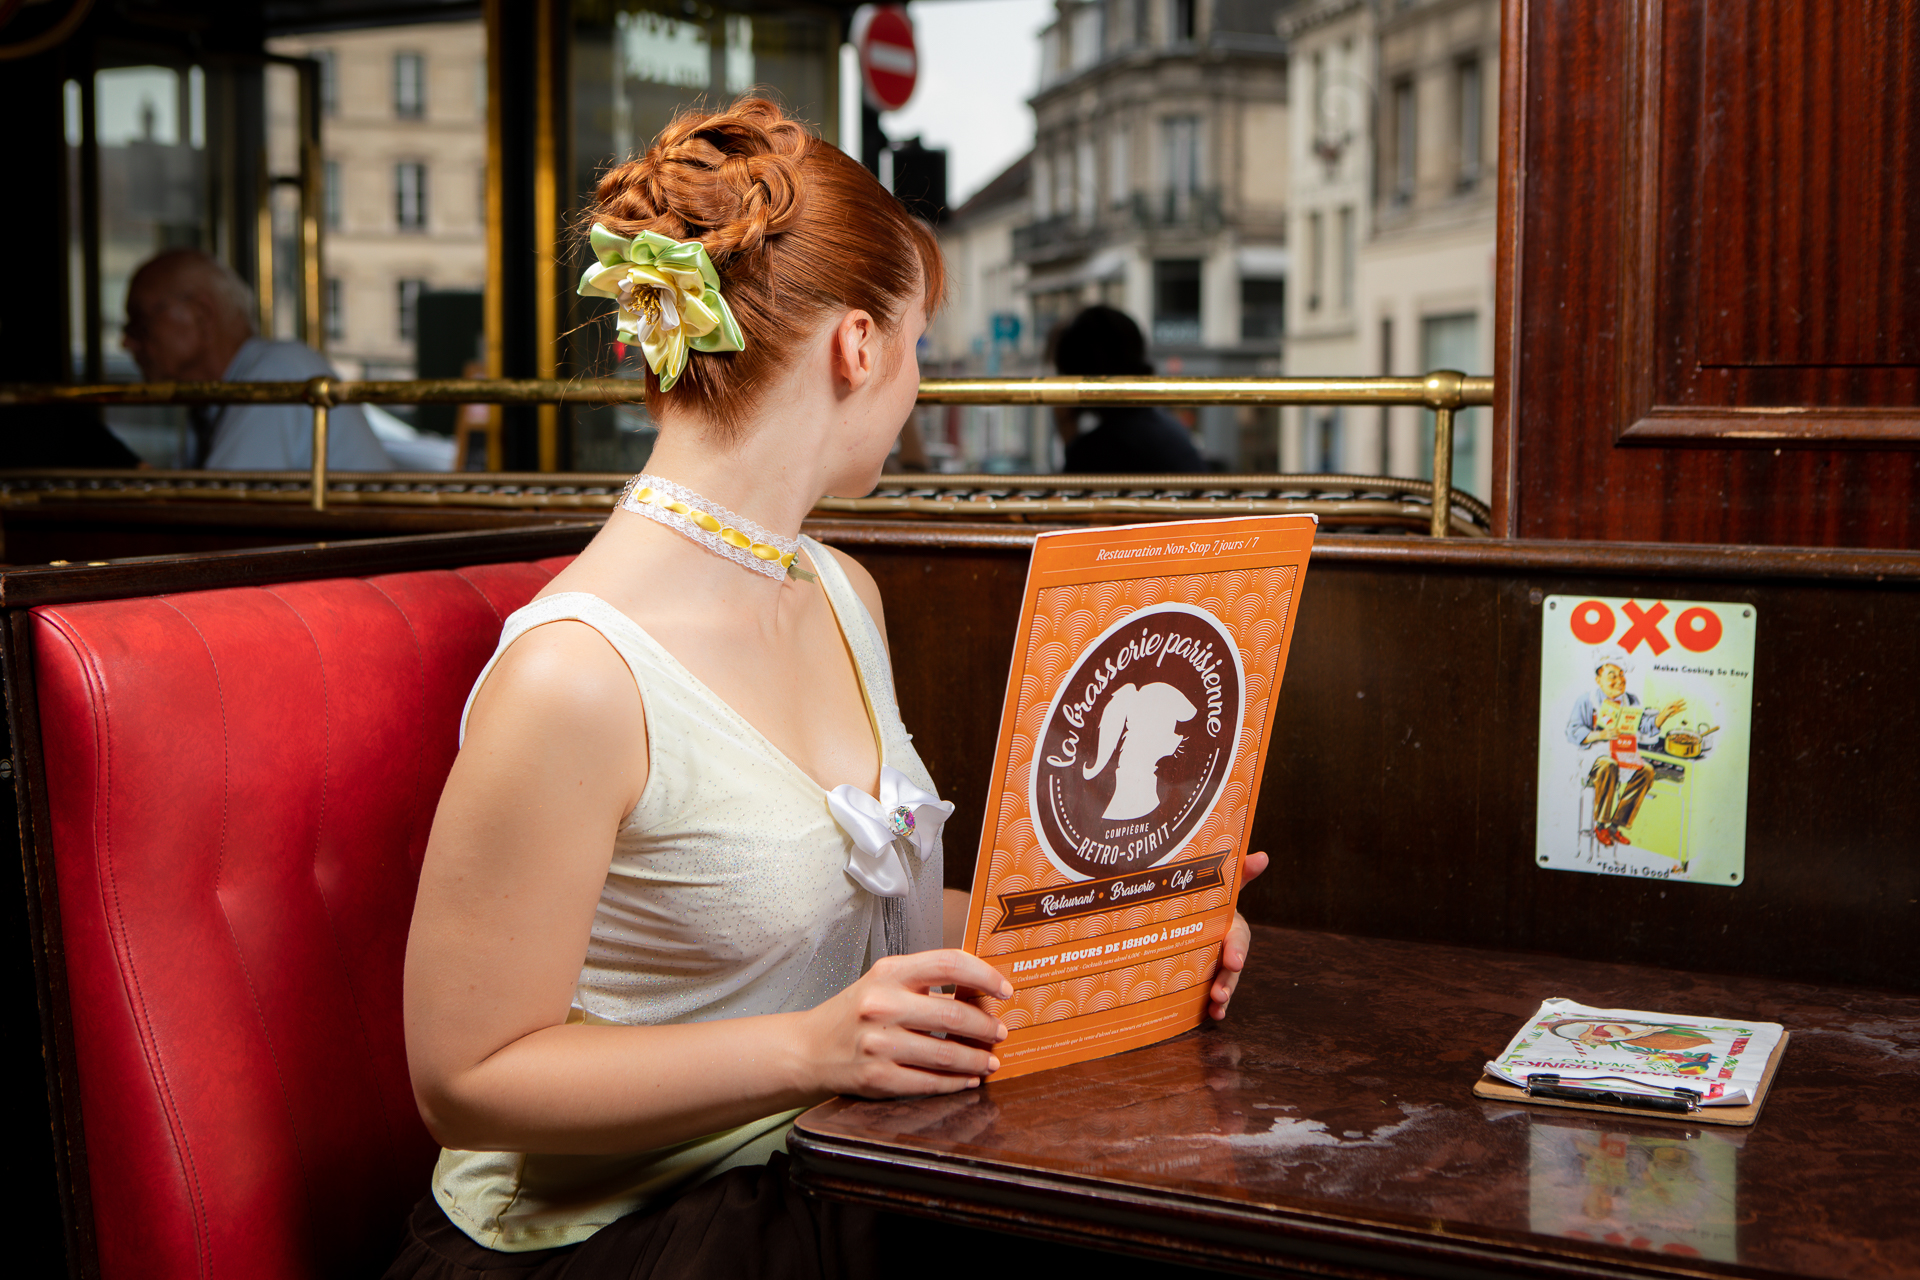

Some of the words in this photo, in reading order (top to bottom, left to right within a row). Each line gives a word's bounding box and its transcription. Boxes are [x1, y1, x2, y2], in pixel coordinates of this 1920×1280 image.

[1163, 541, 1211, 557] Non-Stop
[1212, 540, 1219, 552] 7
[1215, 539, 1244, 556] jours
[1252, 536, 1259, 548] 7
[1096, 545, 1162, 561] Restauration
[1570, 598, 1723, 657] OXO
[1681, 665, 1714, 677] Cooking
[1046, 730, 1080, 768] la
[1063, 628, 1164, 728] brasserie
[1156, 632, 1223, 738] parisienne
[1105, 822, 1150, 840] COMPIÈGNE
[1076, 822, 1170, 865] RETRO-SPIRIT
[1630, 865, 1638, 875] is
[1041, 889, 1095, 916] Restaurant
[1110, 879, 1156, 900] Brasserie
[1170, 869, 1194, 889] Café
[1012, 955, 1058, 973] HAPPY
[1060, 946, 1102, 963] HOURS
[1104, 942, 1120, 954] DE
[1121, 933, 1158, 950] 18H00
[1160, 927, 1168, 941] À
[1169, 921, 1203, 939] 19H30
